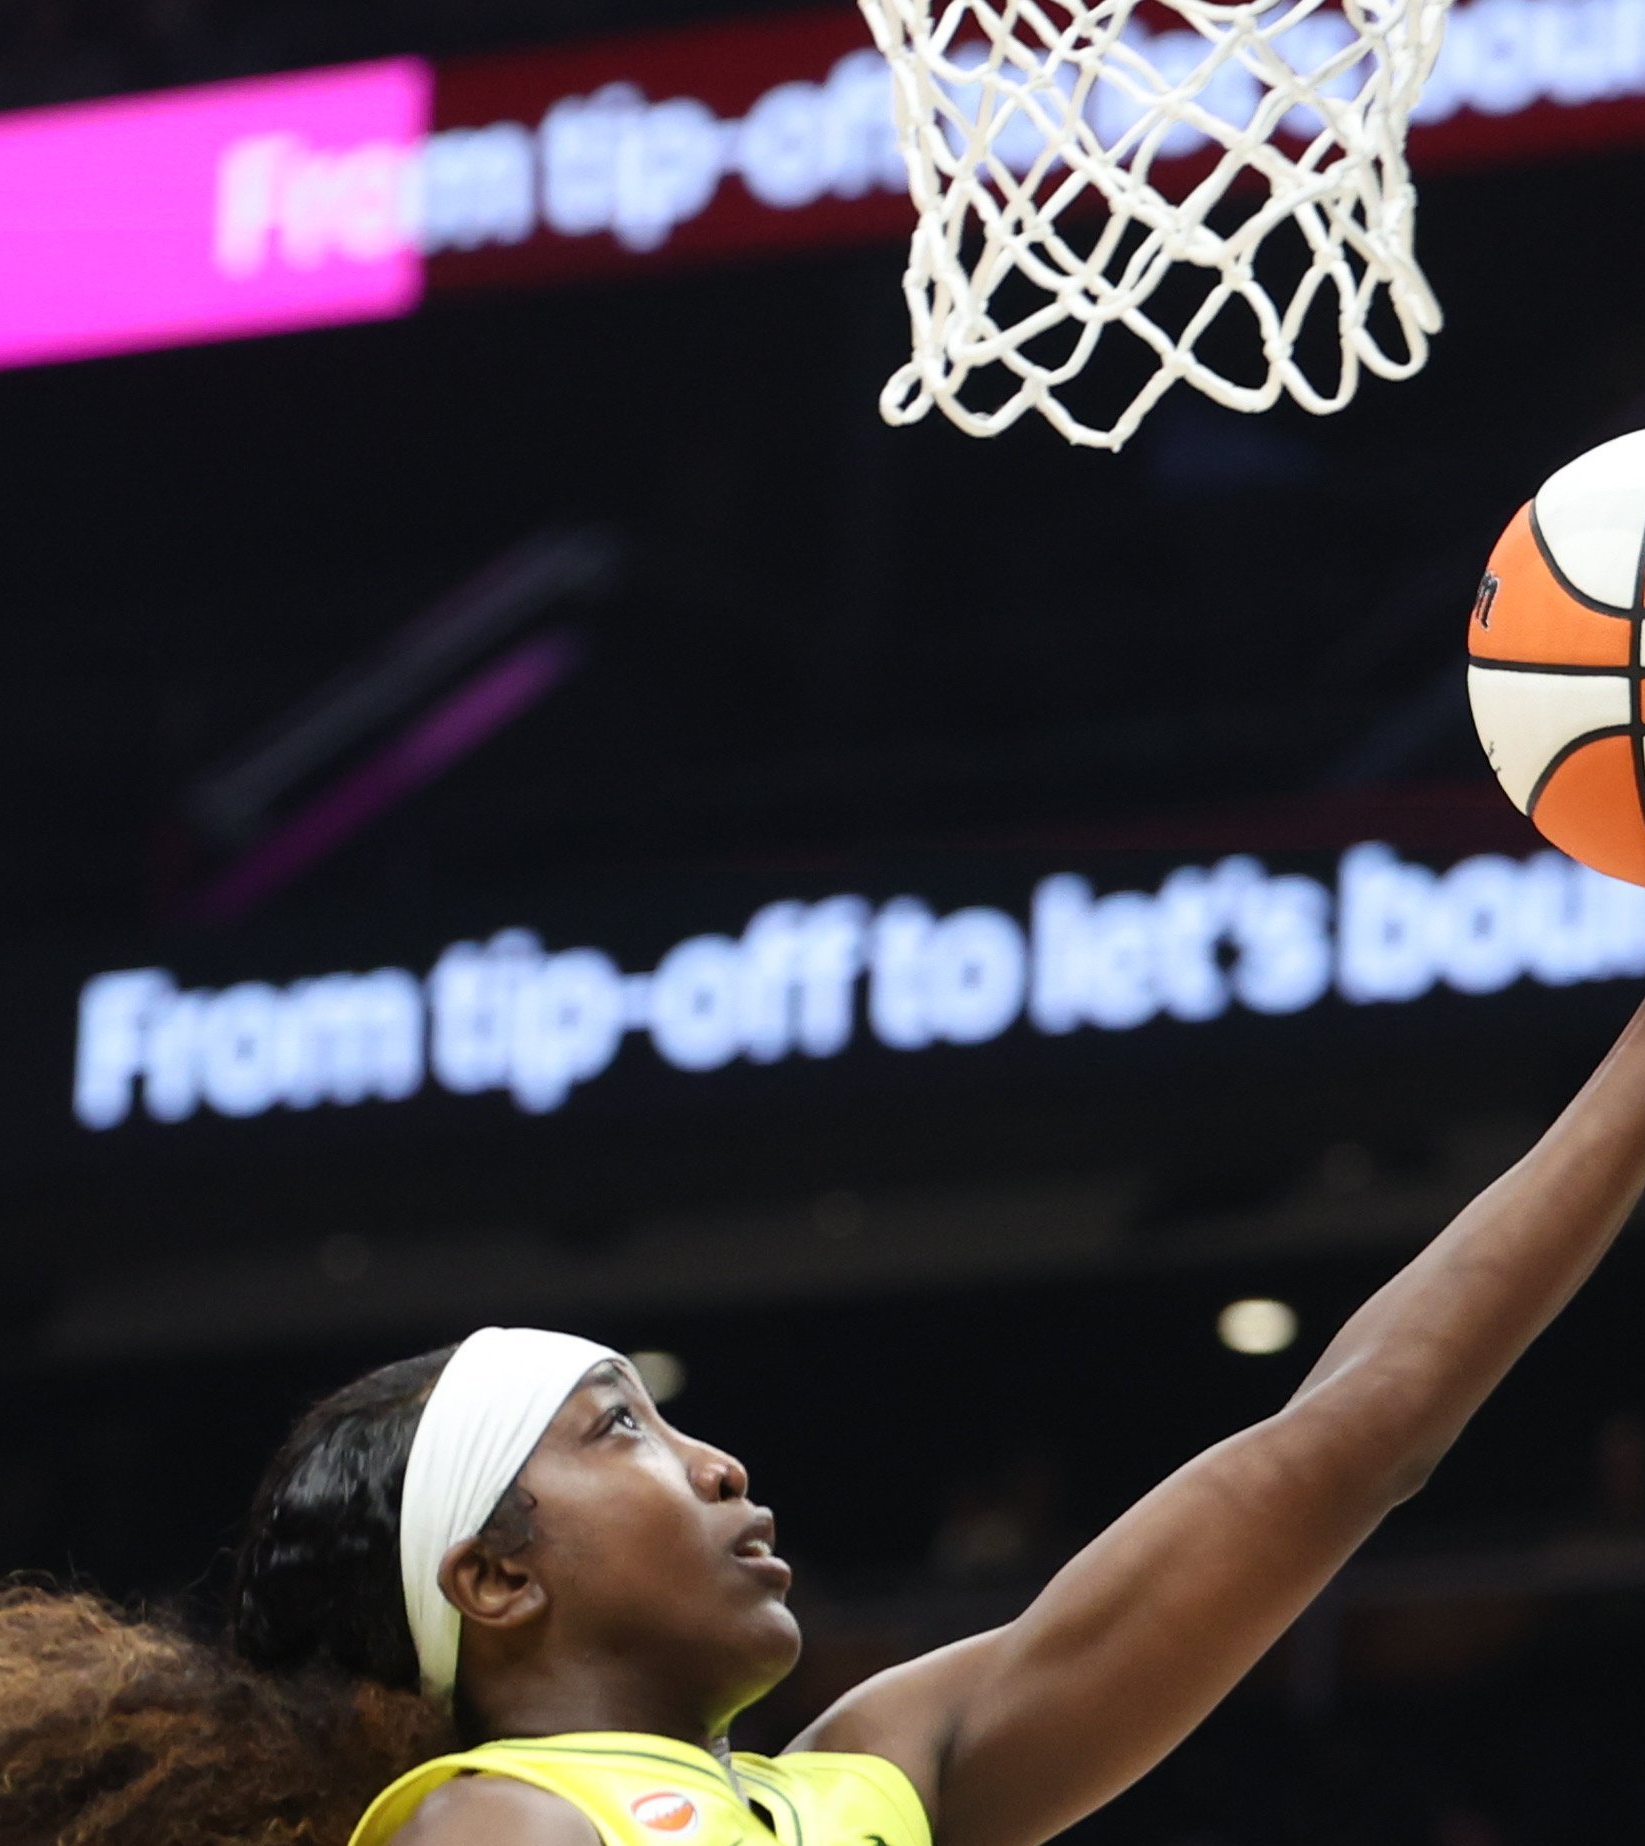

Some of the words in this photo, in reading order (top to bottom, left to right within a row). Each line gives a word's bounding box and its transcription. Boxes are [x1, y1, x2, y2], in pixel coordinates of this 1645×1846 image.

[212, 124, 538, 279] From
[73, 966, 427, 1128] From
[429, 896, 862, 1113] tip-off
[864, 890, 1028, 1049] to
[1029, 855, 1332, 1035] let's
